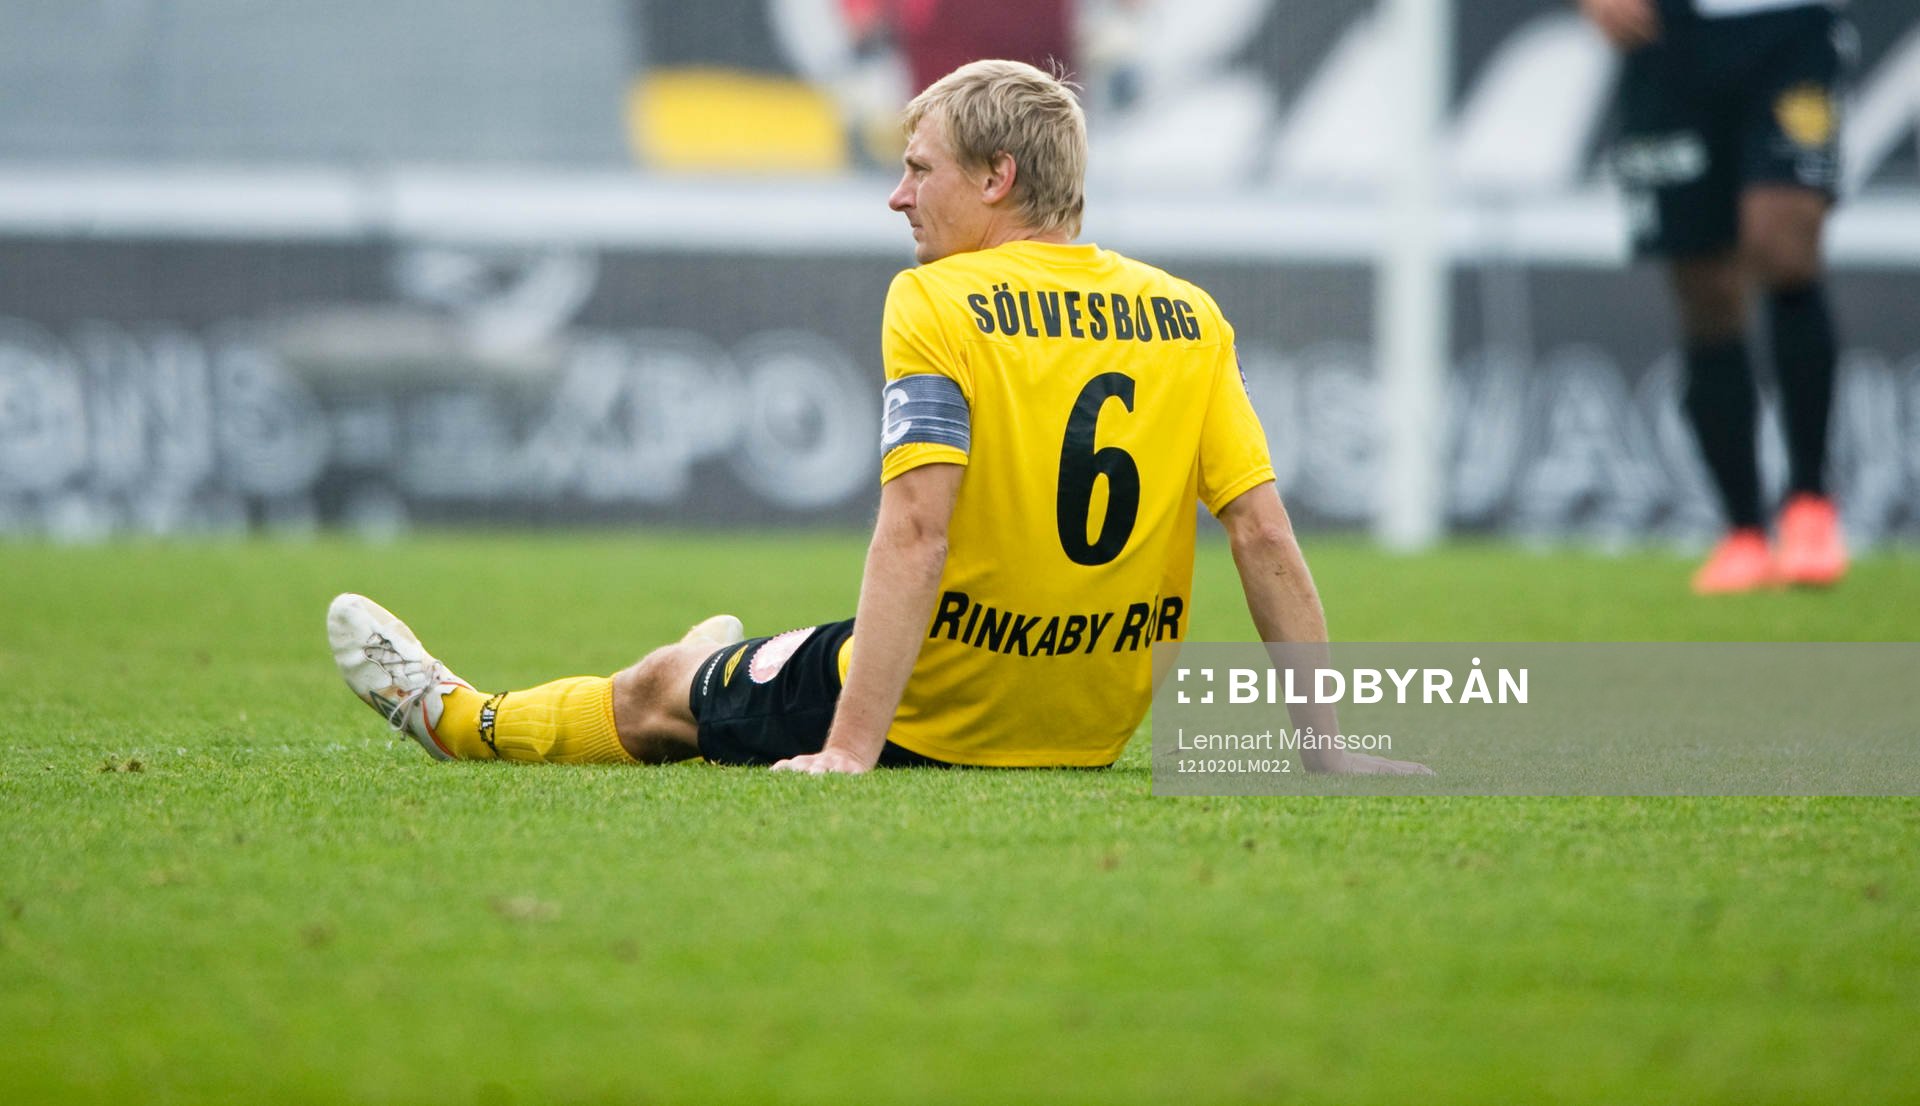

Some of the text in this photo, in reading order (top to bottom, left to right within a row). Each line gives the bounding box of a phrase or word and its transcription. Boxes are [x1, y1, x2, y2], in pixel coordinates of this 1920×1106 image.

[968, 282, 1201, 342] SÖLVESBORG
[883, 388, 912, 444] C
[1057, 372, 1140, 566] 6
[929, 591, 1114, 657] RINKABY
